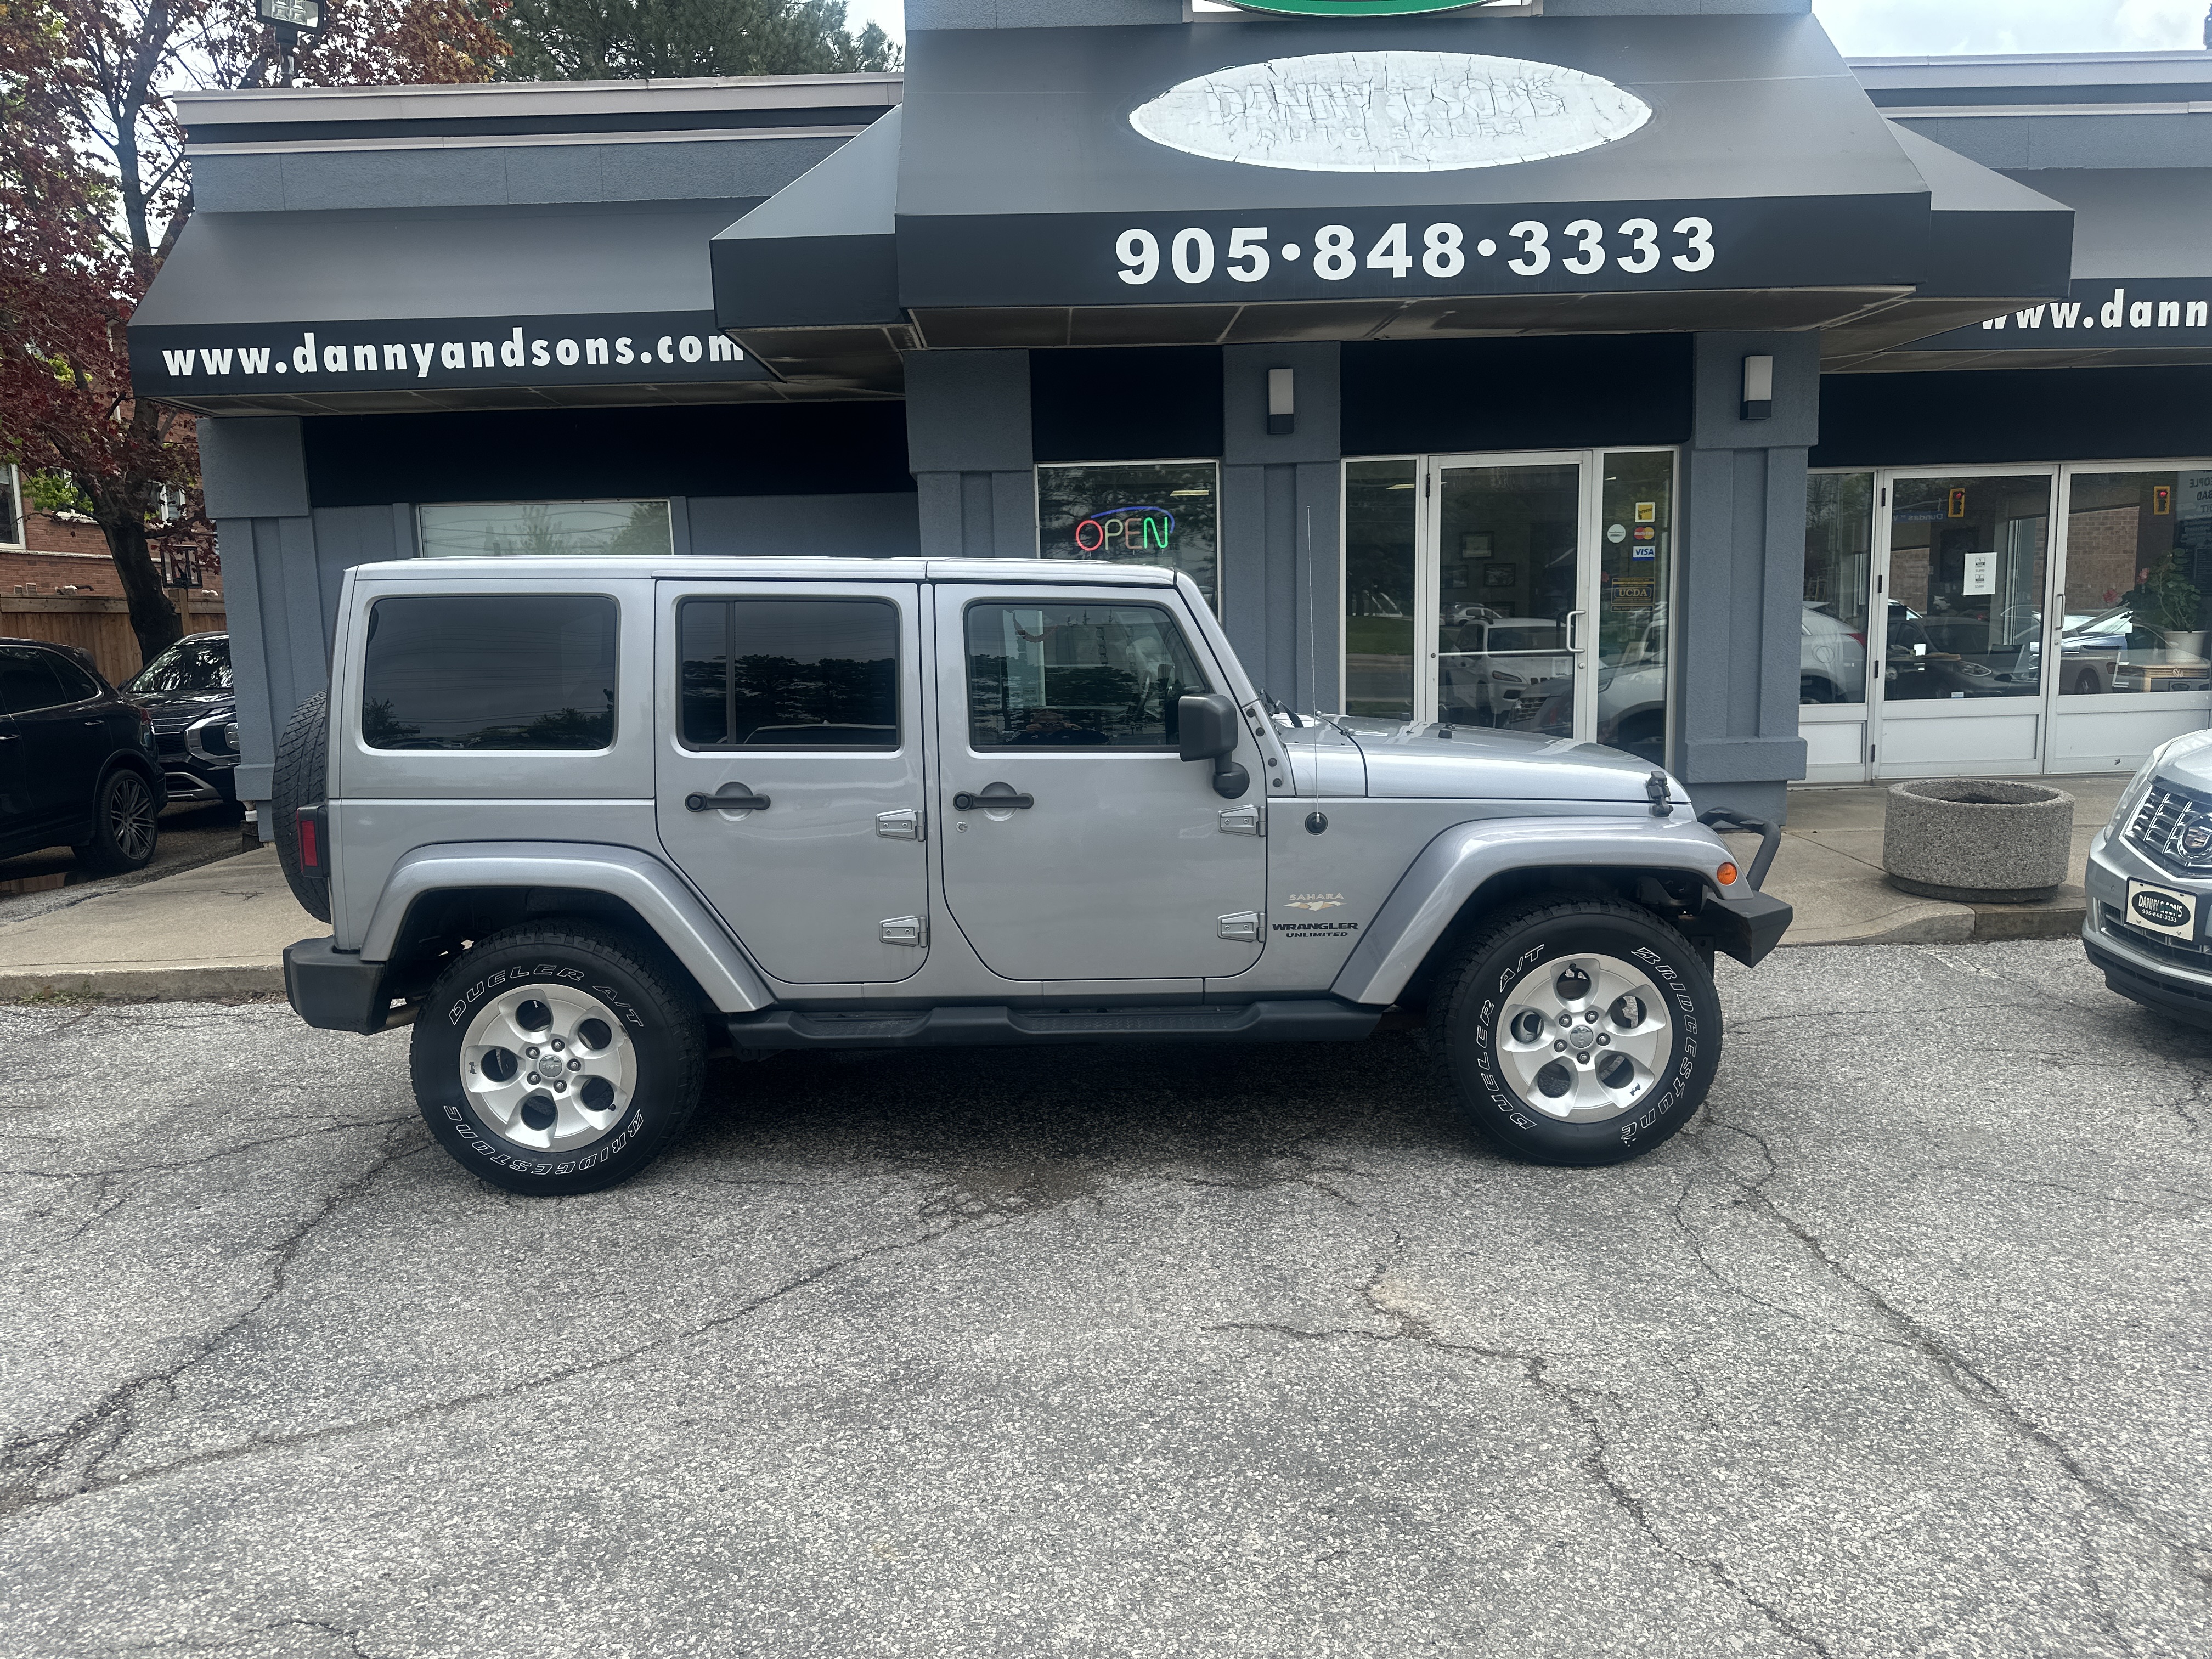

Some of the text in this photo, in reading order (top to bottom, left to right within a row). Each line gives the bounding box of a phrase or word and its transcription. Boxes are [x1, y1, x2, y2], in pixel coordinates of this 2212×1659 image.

[1205, 81, 1374, 125] DANNY
[1431, 78, 1566, 121] SONS
[1257, 124, 1364, 145] AUTO
[162, 326, 744, 378] www.dannyandsons.com
[1075, 516, 1169, 551] OPEN
[1635, 548, 1654, 556] VISA
[1289, 893, 1344, 901] SAHARA
[2138, 895, 2160, 912] DANNY
[1272, 922, 1358, 930] WRANGLER
[2142, 909, 2177, 923] 905-848-3333
[449, 964, 644, 1028] DUELER A/T
[1477, 944, 1544, 1130] DUELER A/T
[1621, 947, 1699, 1140] BRIDGESTONE
[443, 1105, 644, 1175] BRIDGESTONE
